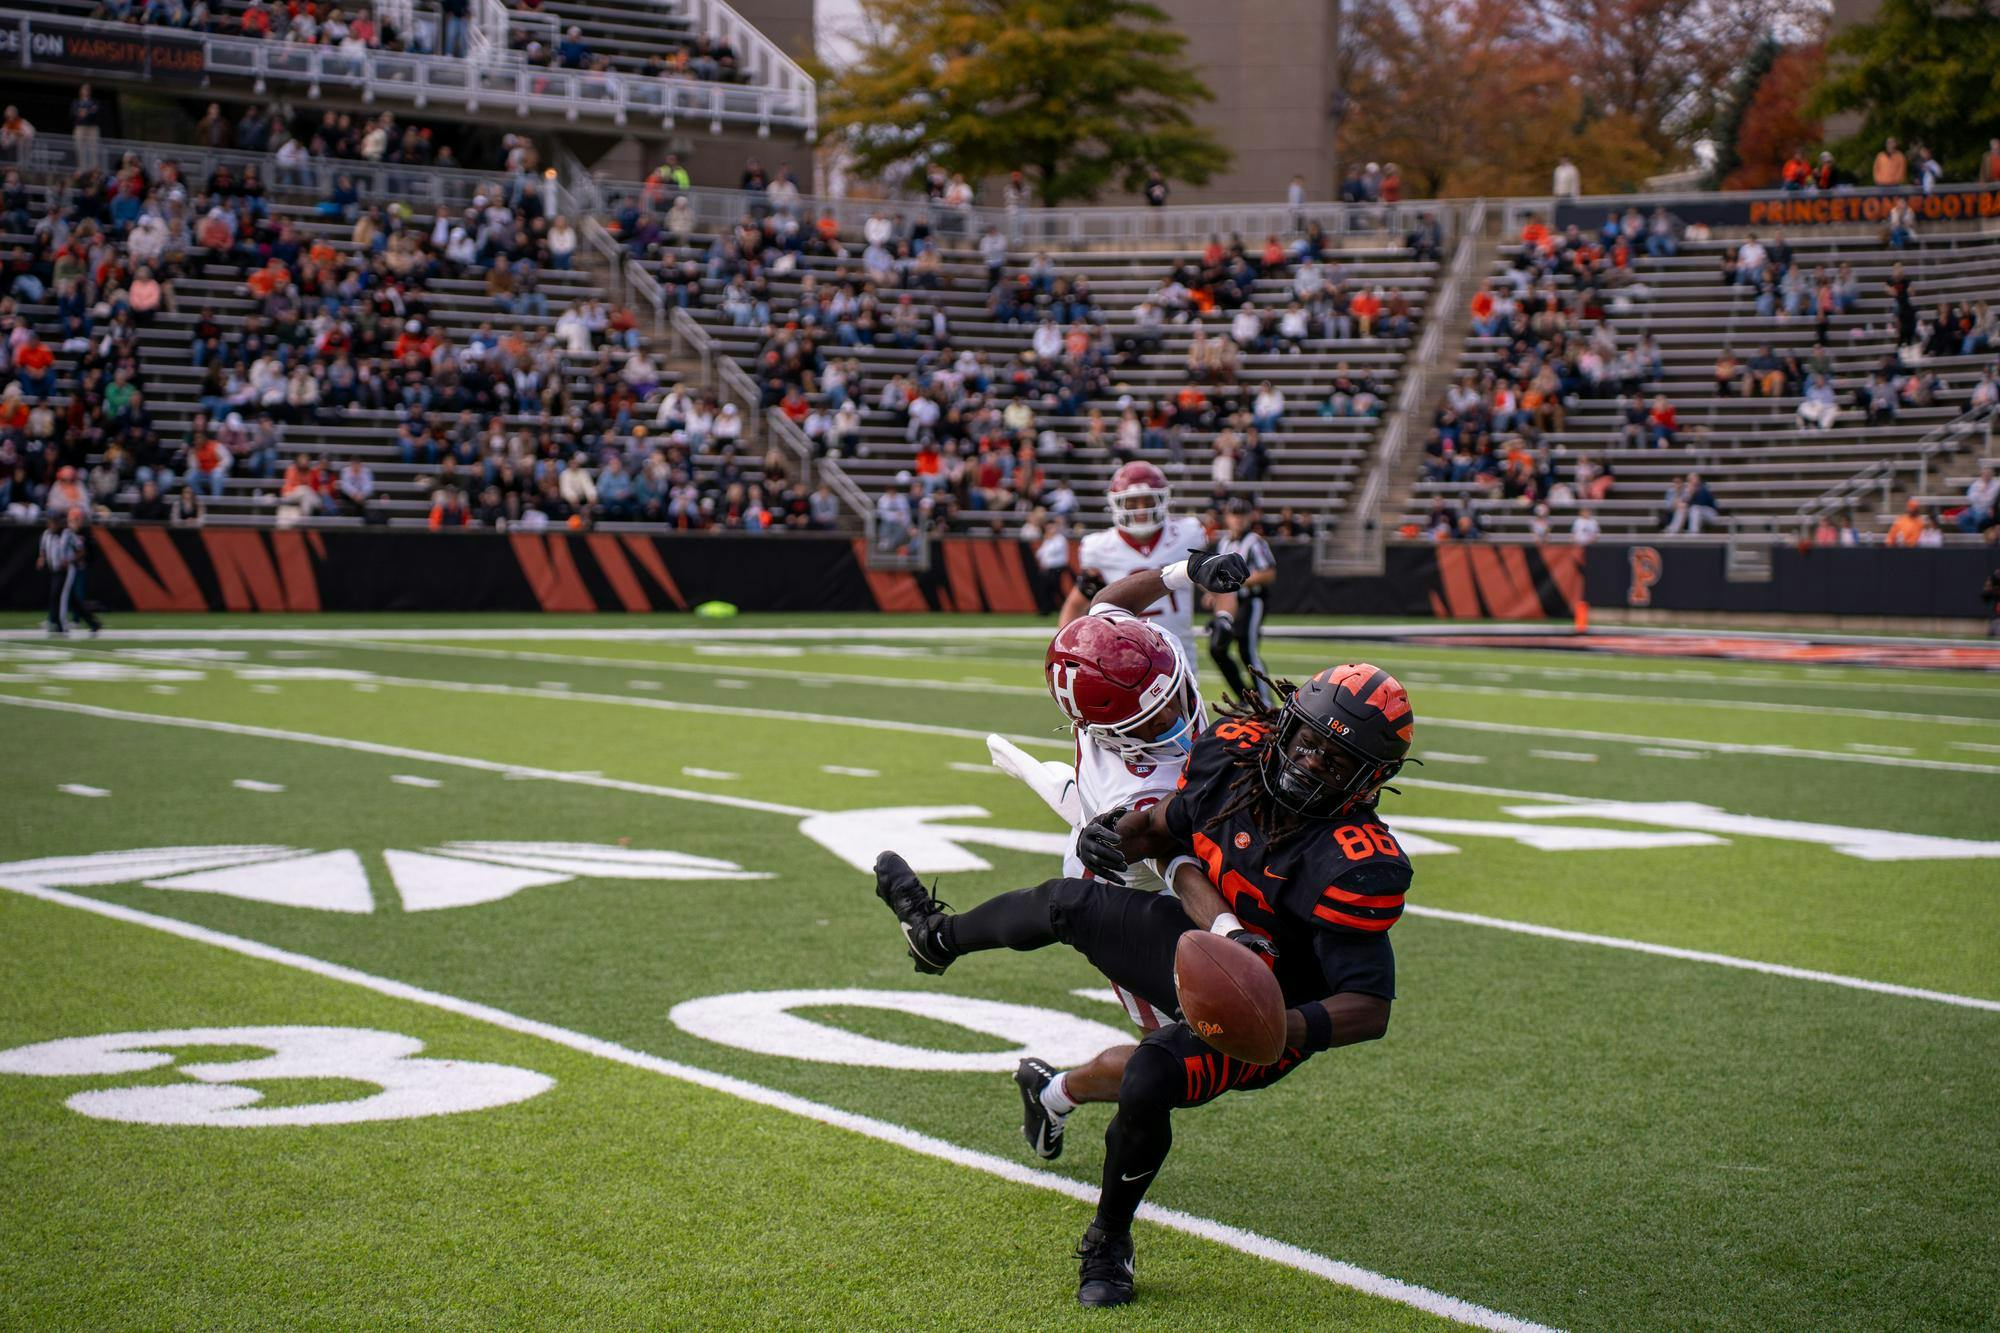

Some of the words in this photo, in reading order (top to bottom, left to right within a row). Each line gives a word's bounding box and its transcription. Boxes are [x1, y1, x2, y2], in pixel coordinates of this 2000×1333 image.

[67, 36, 149, 65] VARSITY
[151, 46, 204, 71] CLUB
[1627, 546, 1663, 606] P
[1053, 663, 1083, 720] H
[1327, 717, 1350, 736] 1869
[1333, 823, 1399, 861] 86
